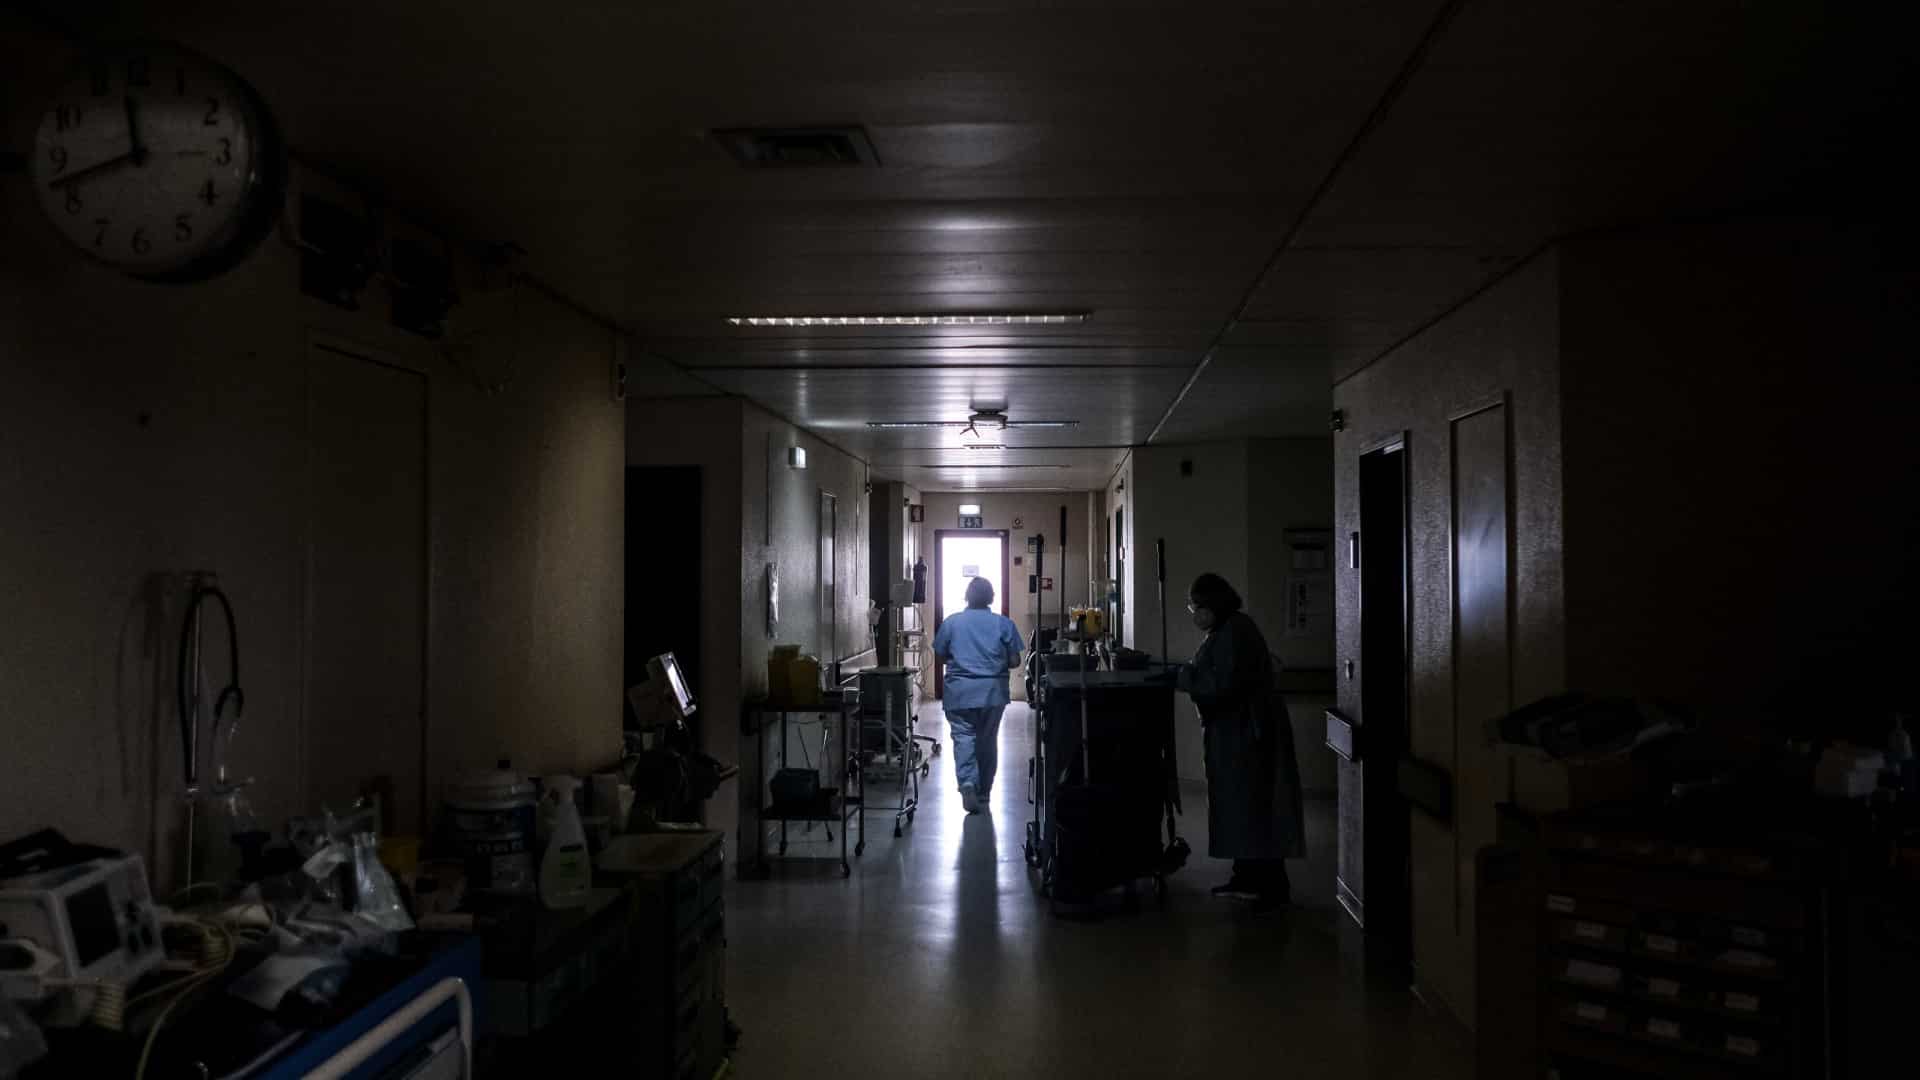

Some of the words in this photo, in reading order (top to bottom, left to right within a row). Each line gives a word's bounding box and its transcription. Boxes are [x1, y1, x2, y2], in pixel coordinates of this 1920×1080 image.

[175, 66, 186, 96] 1
[55, 103, 81, 132] 10
[204, 96, 219, 125] 2
[50, 146, 67, 172] 9
[214, 138, 231, 167] 3
[65, 182, 82, 214] 8
[199, 180, 219, 206] 4
[95, 217, 109, 248] 7
[132, 230, 151, 254] 6
[176, 214, 192, 241] 5
